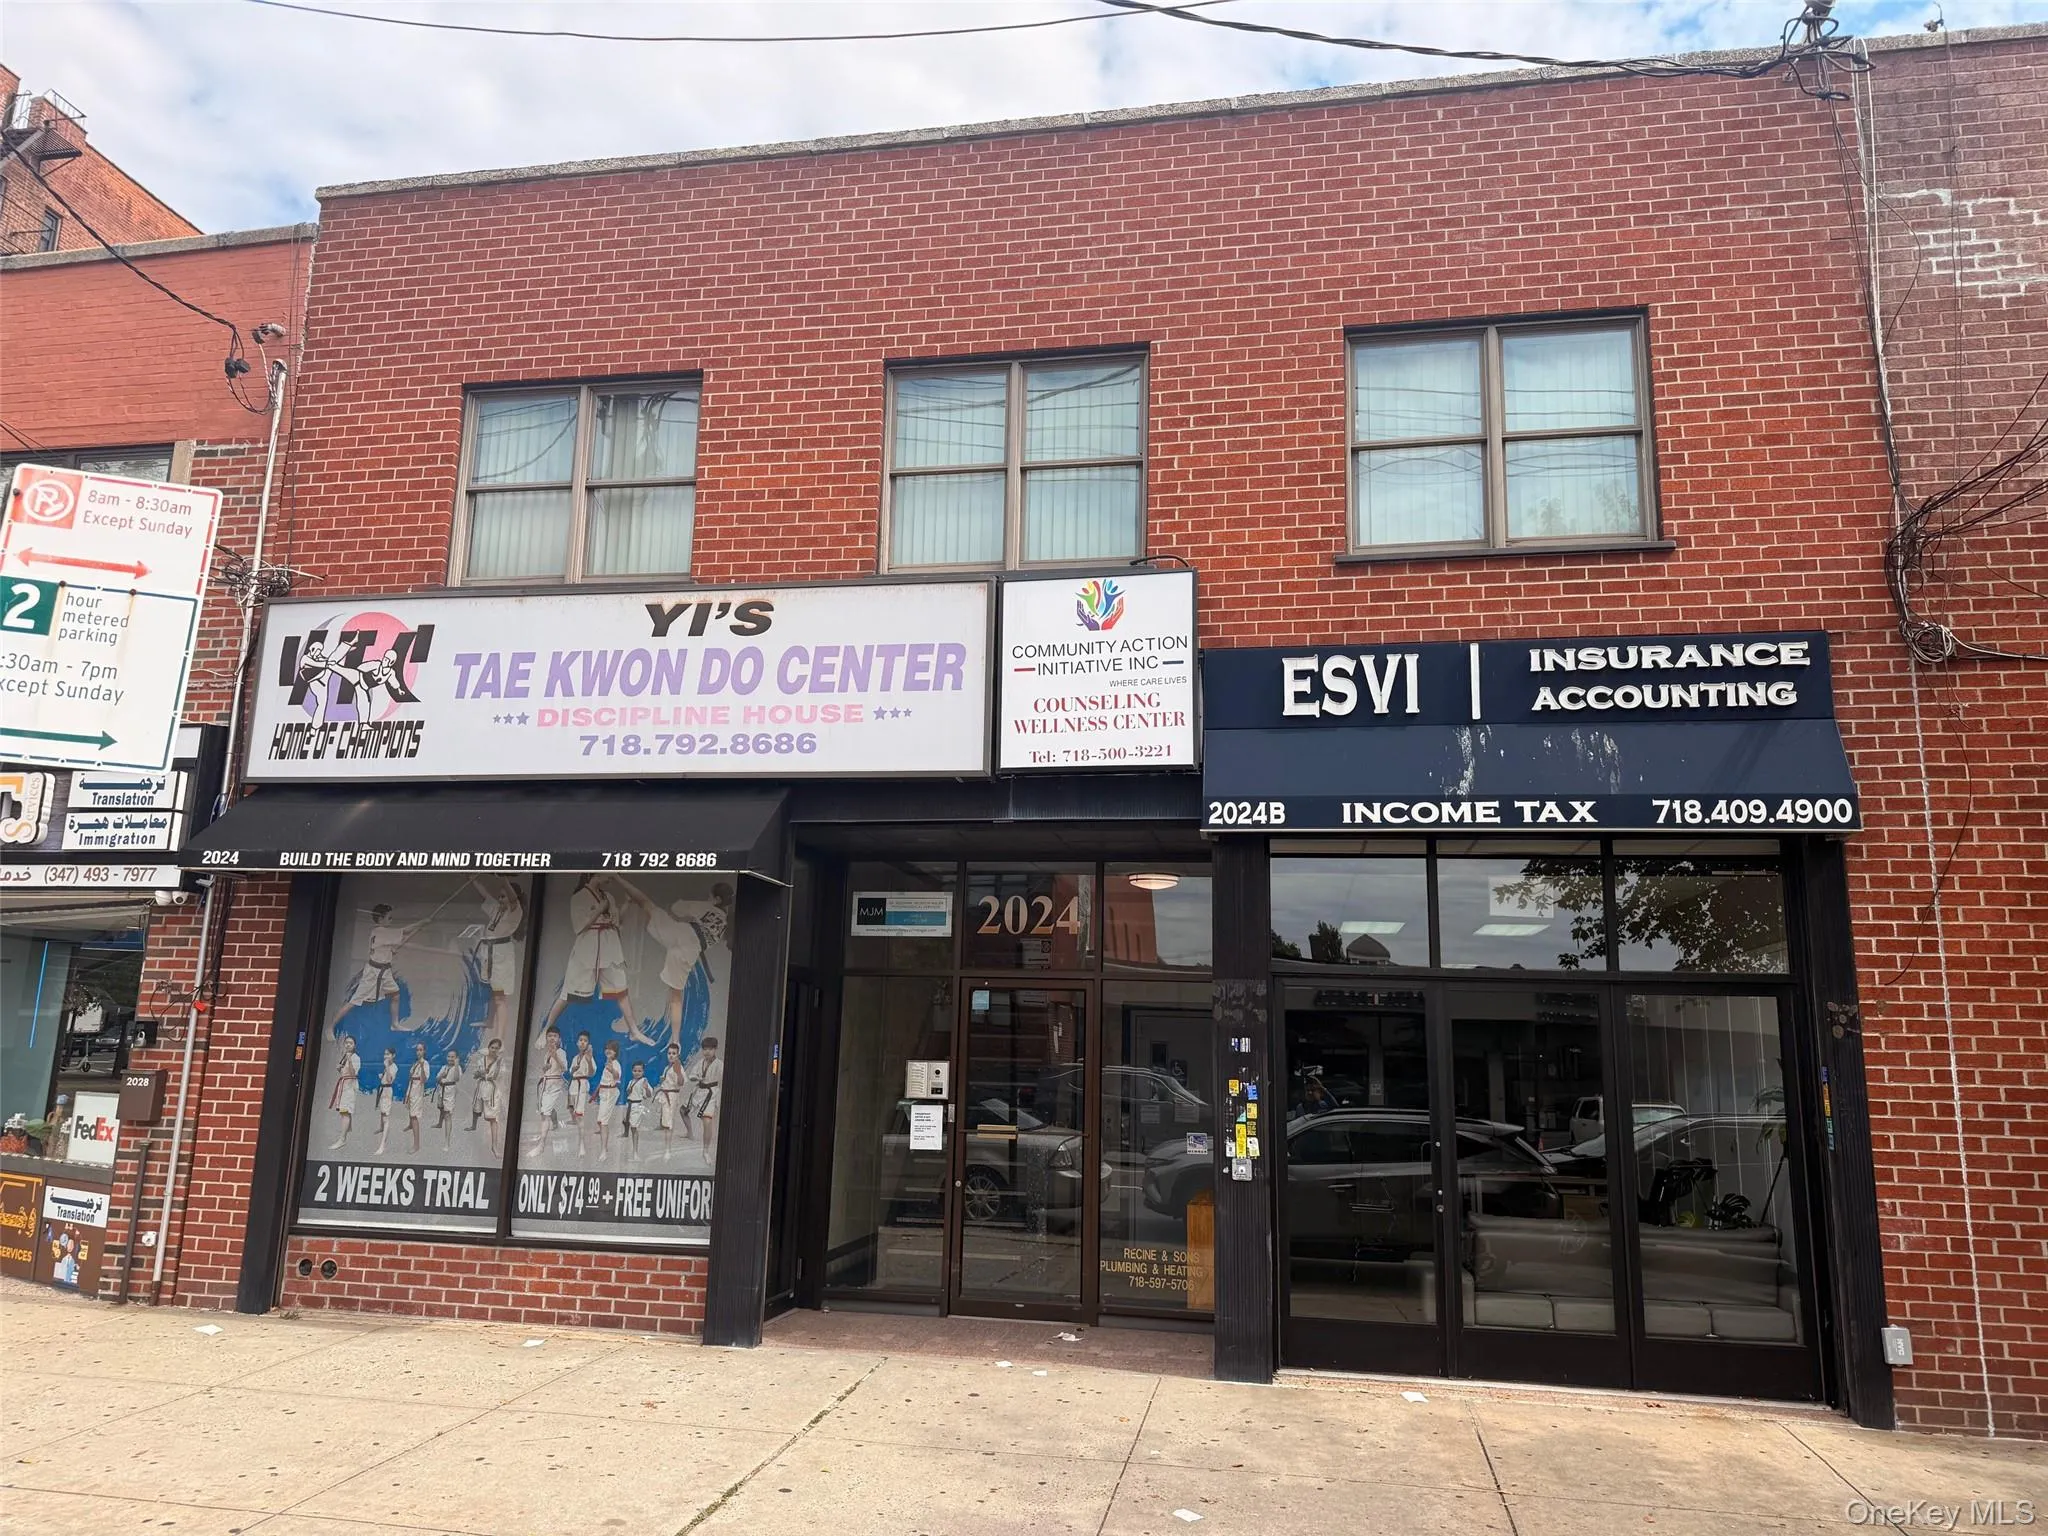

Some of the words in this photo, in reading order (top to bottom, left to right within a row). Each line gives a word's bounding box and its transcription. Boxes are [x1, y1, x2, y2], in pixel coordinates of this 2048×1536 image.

[87, 490, 120, 507] 8am
[136, 495, 192, 516] 8:30am
[83, 510, 134, 530] Except
[139, 518, 193, 539] Sunday
[3, 582, 41, 629] 2
[66, 592, 103, 609] hour
[62, 611, 130, 629] metered
[644, 600, 775, 638] YI'S
[58, 627, 118, 646] parking
[1012, 640, 1117, 659] COMMUNITY
[1120, 635, 1188, 652] ACTION
[0, 653, 58, 674] :30am
[80, 660, 118, 681] 7pm
[1038, 658, 1123, 675] INITIATIVE
[1129, 655, 1159, 670] INC
[1529, 641, 1811, 672] INSURANCE
[453, 651, 536, 699] TAE
[544, 648, 687, 697] KWON
[697, 646, 763, 696] DO
[777, 642, 966, 695] CENTER
[1110, 679, 1138, 687] WHERE
[1140, 678, 1164, 686] CARE
[1165, 676, 1187, 685] LIVES
[0, 679, 47, 697] xcept
[55, 679, 124, 706] Sunday
[1282, 654, 1420, 718] ESVI
[1531, 681, 1797, 711] ACCOUNTING
[1034, 692, 1161, 714] COUNSELING
[537, 706, 730, 727] DISCIPLINE
[743, 704, 864, 725] HOUSE
[1014, 716, 1108, 734] WELLNESS
[1113, 711, 1186, 730] CENTER
[268, 723, 315, 760] HOME
[313, 722, 339, 760] OF
[335, 721, 425, 760] CHAMPIONS
[579, 732, 817, 756] 718.792.8686
[1029, 751, 1056, 763] Tel:
[1062, 744, 1171, 762] 718-500-3221
[92, 792, 154, 806] Translation
[1208, 801, 1285, 825] 2024B
[1342, 801, 1500, 825] INCOME
[1514, 800, 1598, 824] TAX
[1652, 799, 1852, 824] 718.409.4900
[79, 833, 156, 848] Immigration
[201, 850, 239, 865] 2024
[280, 852, 321, 866] BUILD
[325, 852, 351, 866] THE
[355, 852, 395, 866] BODY
[396, 852, 428, 866] AND
[431, 852, 471, 866] MIND
[474, 852, 551, 867] TOGETHER
[602, 853, 631, 867] 718
[639, 853, 669, 867] 792
[675, 853, 717, 867] 8686
[44, 866, 78, 884] (347)
[83, 867, 109, 882] 493
[123, 867, 157, 882] 7977
[859, 908, 884, 916] MJM
[977, 895, 1081, 935] 2024
[126, 1076, 150, 1087] 2028
[74, 1115, 114, 1142] FedEx
[314, 1164, 331, 1202] 2
[336, 1166, 415, 1206] WEEKS
[423, 1169, 490, 1210] TRIAL
[518, 1174, 557, 1214] ONLY
[559, 1173, 586, 1219] $74
[587, 1176, 600, 1205] 99
[602, 1189, 613, 1204] +
[614, 1177, 652, 1217] FREE
[656, 1178, 714, 1220] UNIFOR
[56, 1206, 95, 1224] Translation
[1123, 1248, 1157, 1261] RECINE
[1161, 1250, 1168, 1261] &
[1173, 1250, 1200, 1264] SONS
[1100, 1260, 1147, 1274] PLUMBING
[1152, 1263, 1159, 1274] &
[1164, 1264, 1203, 1278] HEATING
